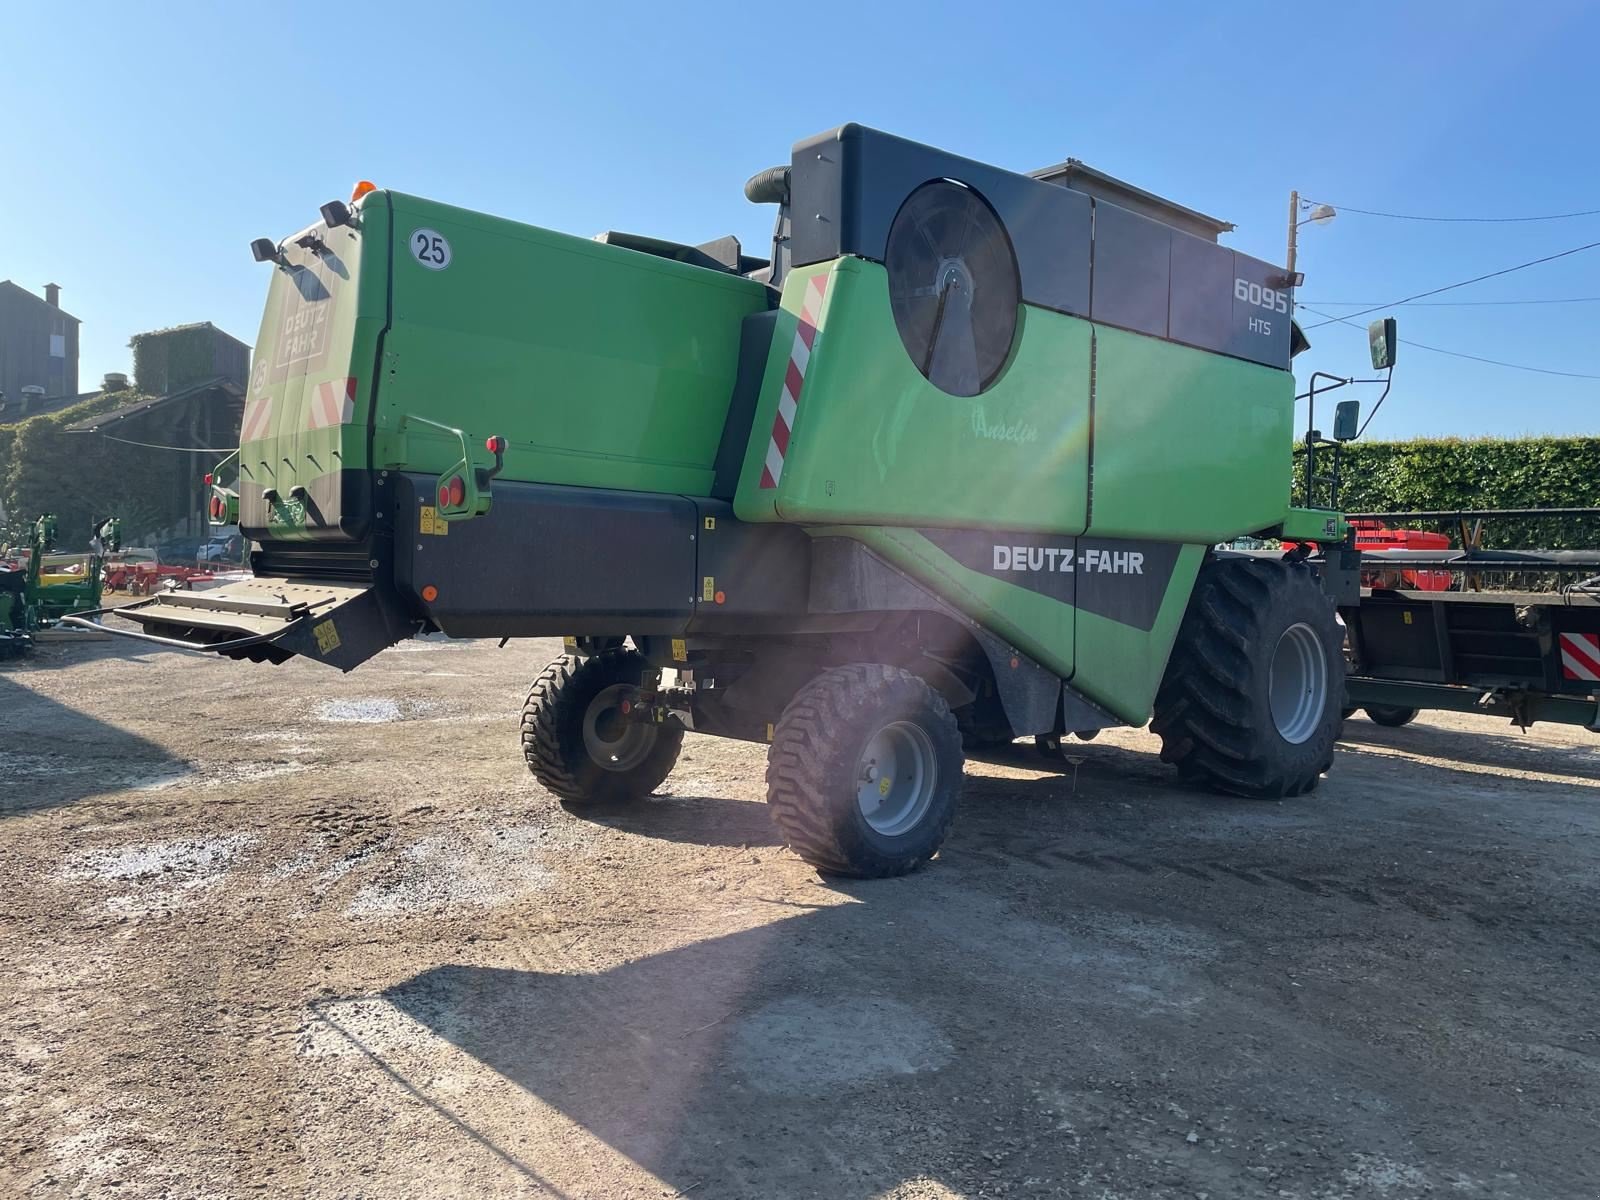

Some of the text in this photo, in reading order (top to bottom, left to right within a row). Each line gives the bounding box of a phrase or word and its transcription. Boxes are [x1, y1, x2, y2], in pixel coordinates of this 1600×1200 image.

[417, 233, 445, 264] 25
[1234, 278, 1288, 314] 6095
[285, 303, 327, 334] DEUTZ
[1248, 316, 1271, 336] HTS
[285, 330, 318, 357] FAHR
[993, 545, 1144, 575] DEUTZ-FAHR
